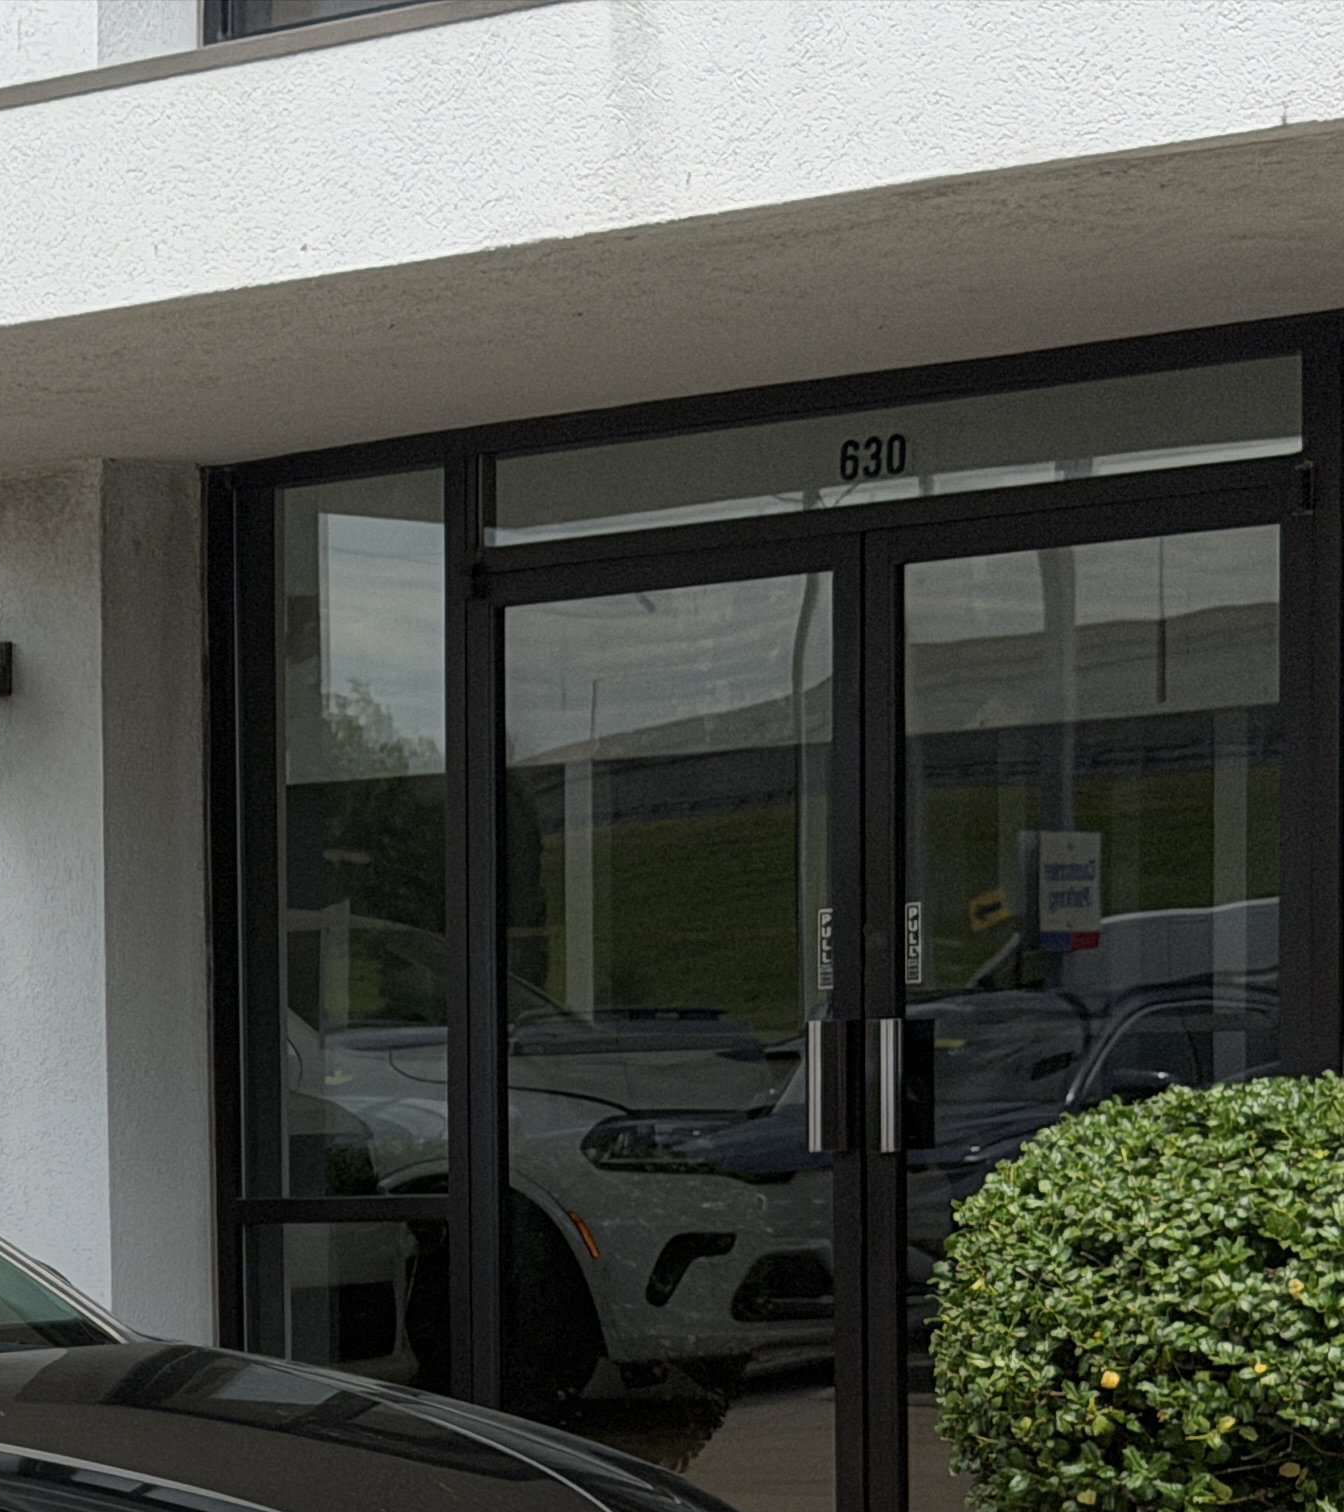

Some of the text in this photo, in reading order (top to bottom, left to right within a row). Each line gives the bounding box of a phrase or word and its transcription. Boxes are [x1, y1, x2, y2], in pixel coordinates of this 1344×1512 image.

[840, 434, 907, 480] 630
[821, 914, 832, 963] PULL
[908, 907, 918, 957] PULL
